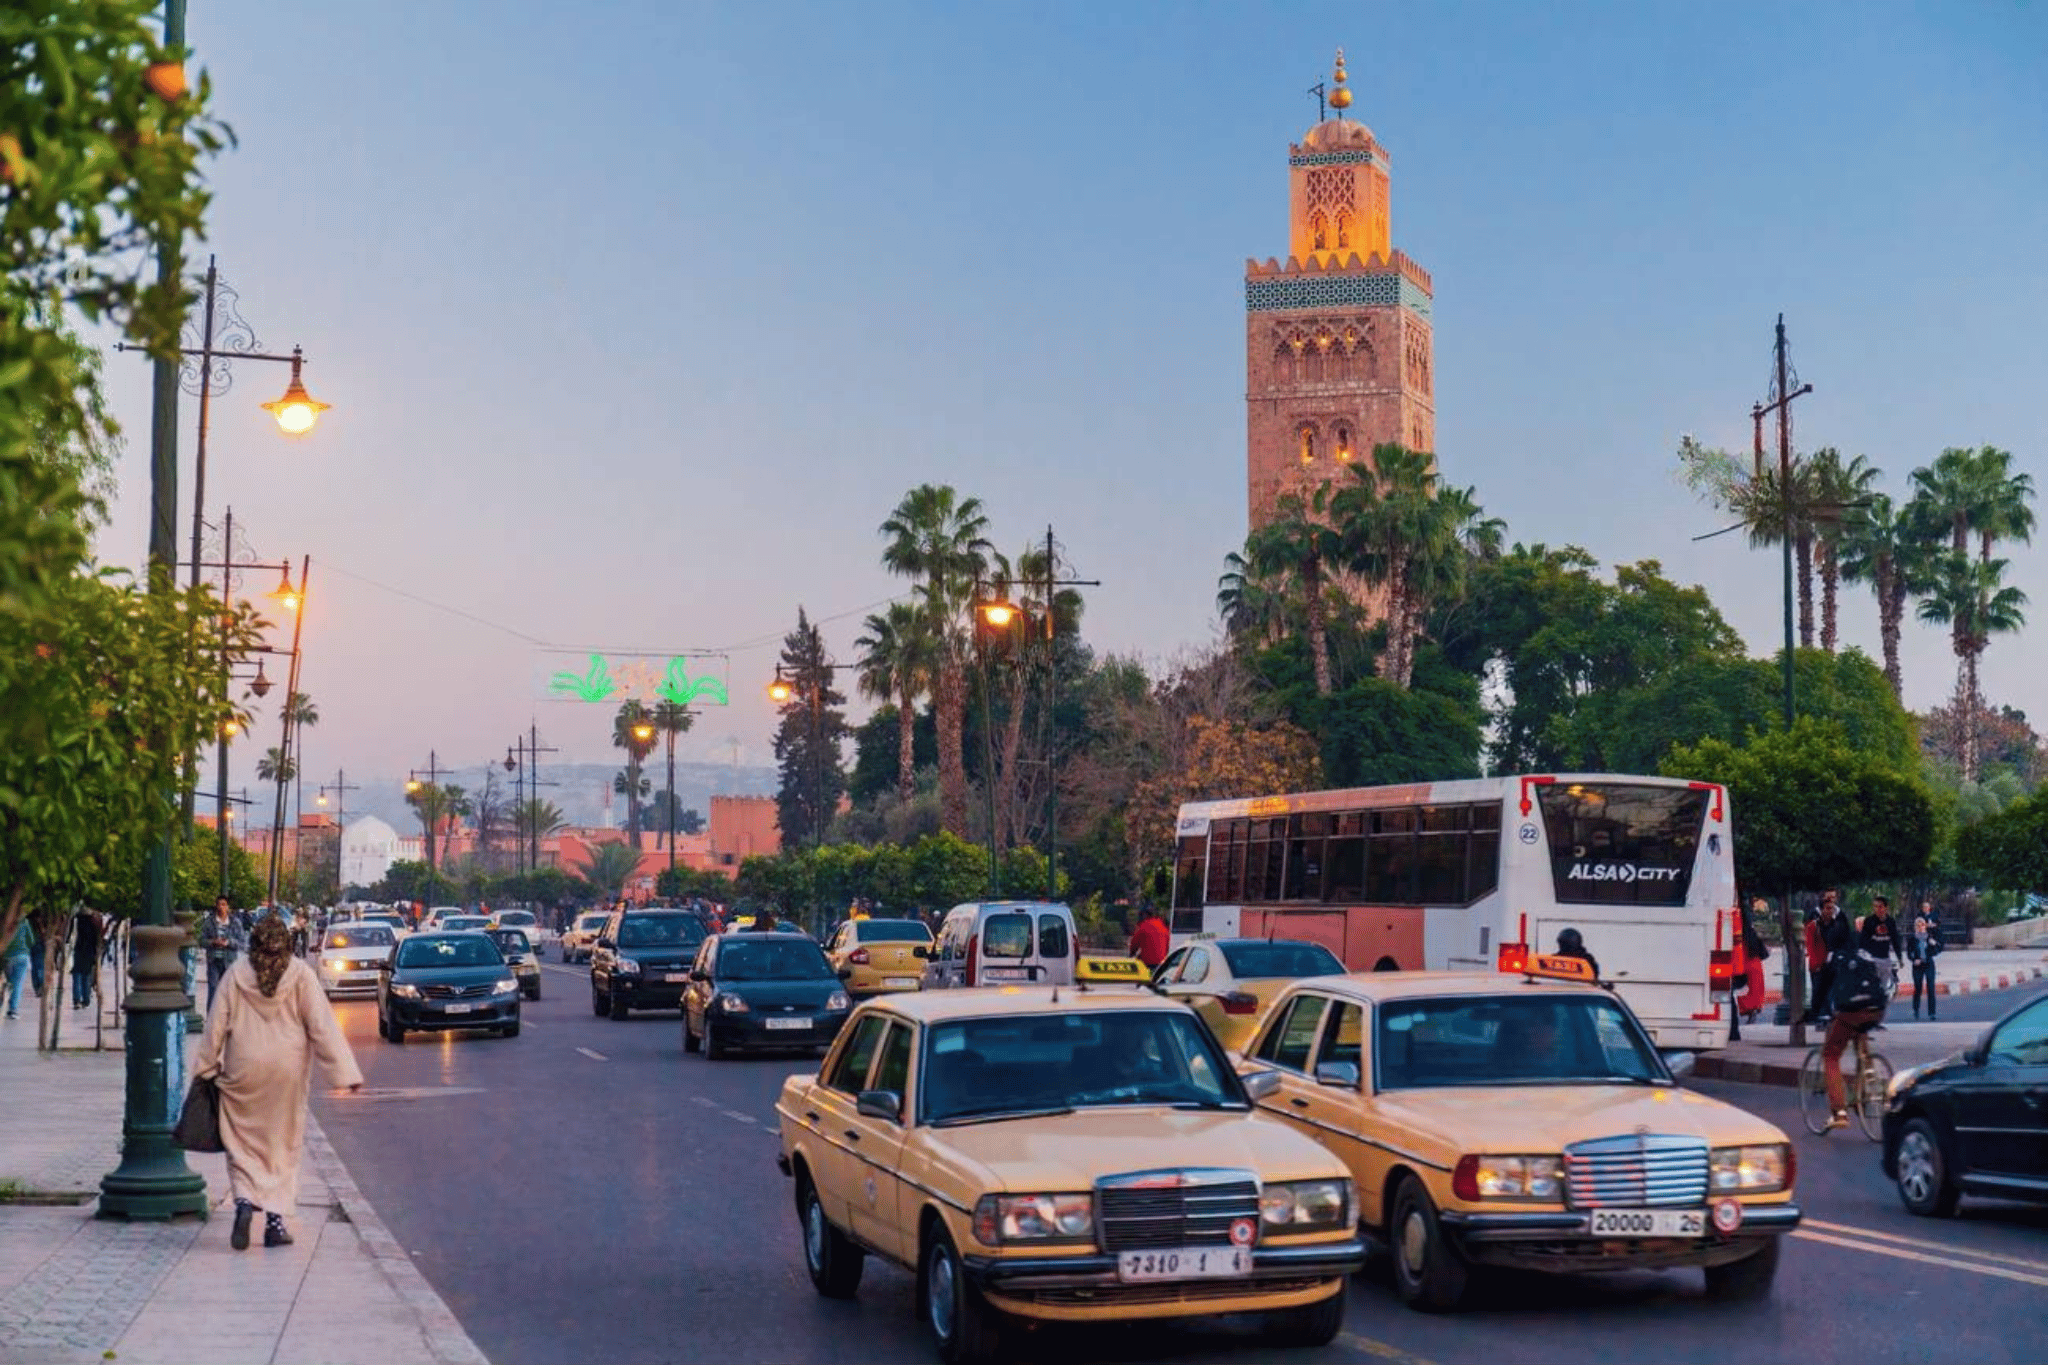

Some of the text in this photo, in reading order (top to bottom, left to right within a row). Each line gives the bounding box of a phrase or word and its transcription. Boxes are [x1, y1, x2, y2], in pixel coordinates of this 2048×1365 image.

[1523, 829, 1536, 838] 22
[1568, 863, 1617, 880] ALSA
[1596, 1213, 1653, 1231] 20000
[1131, 1253, 1179, 1274] 7310
